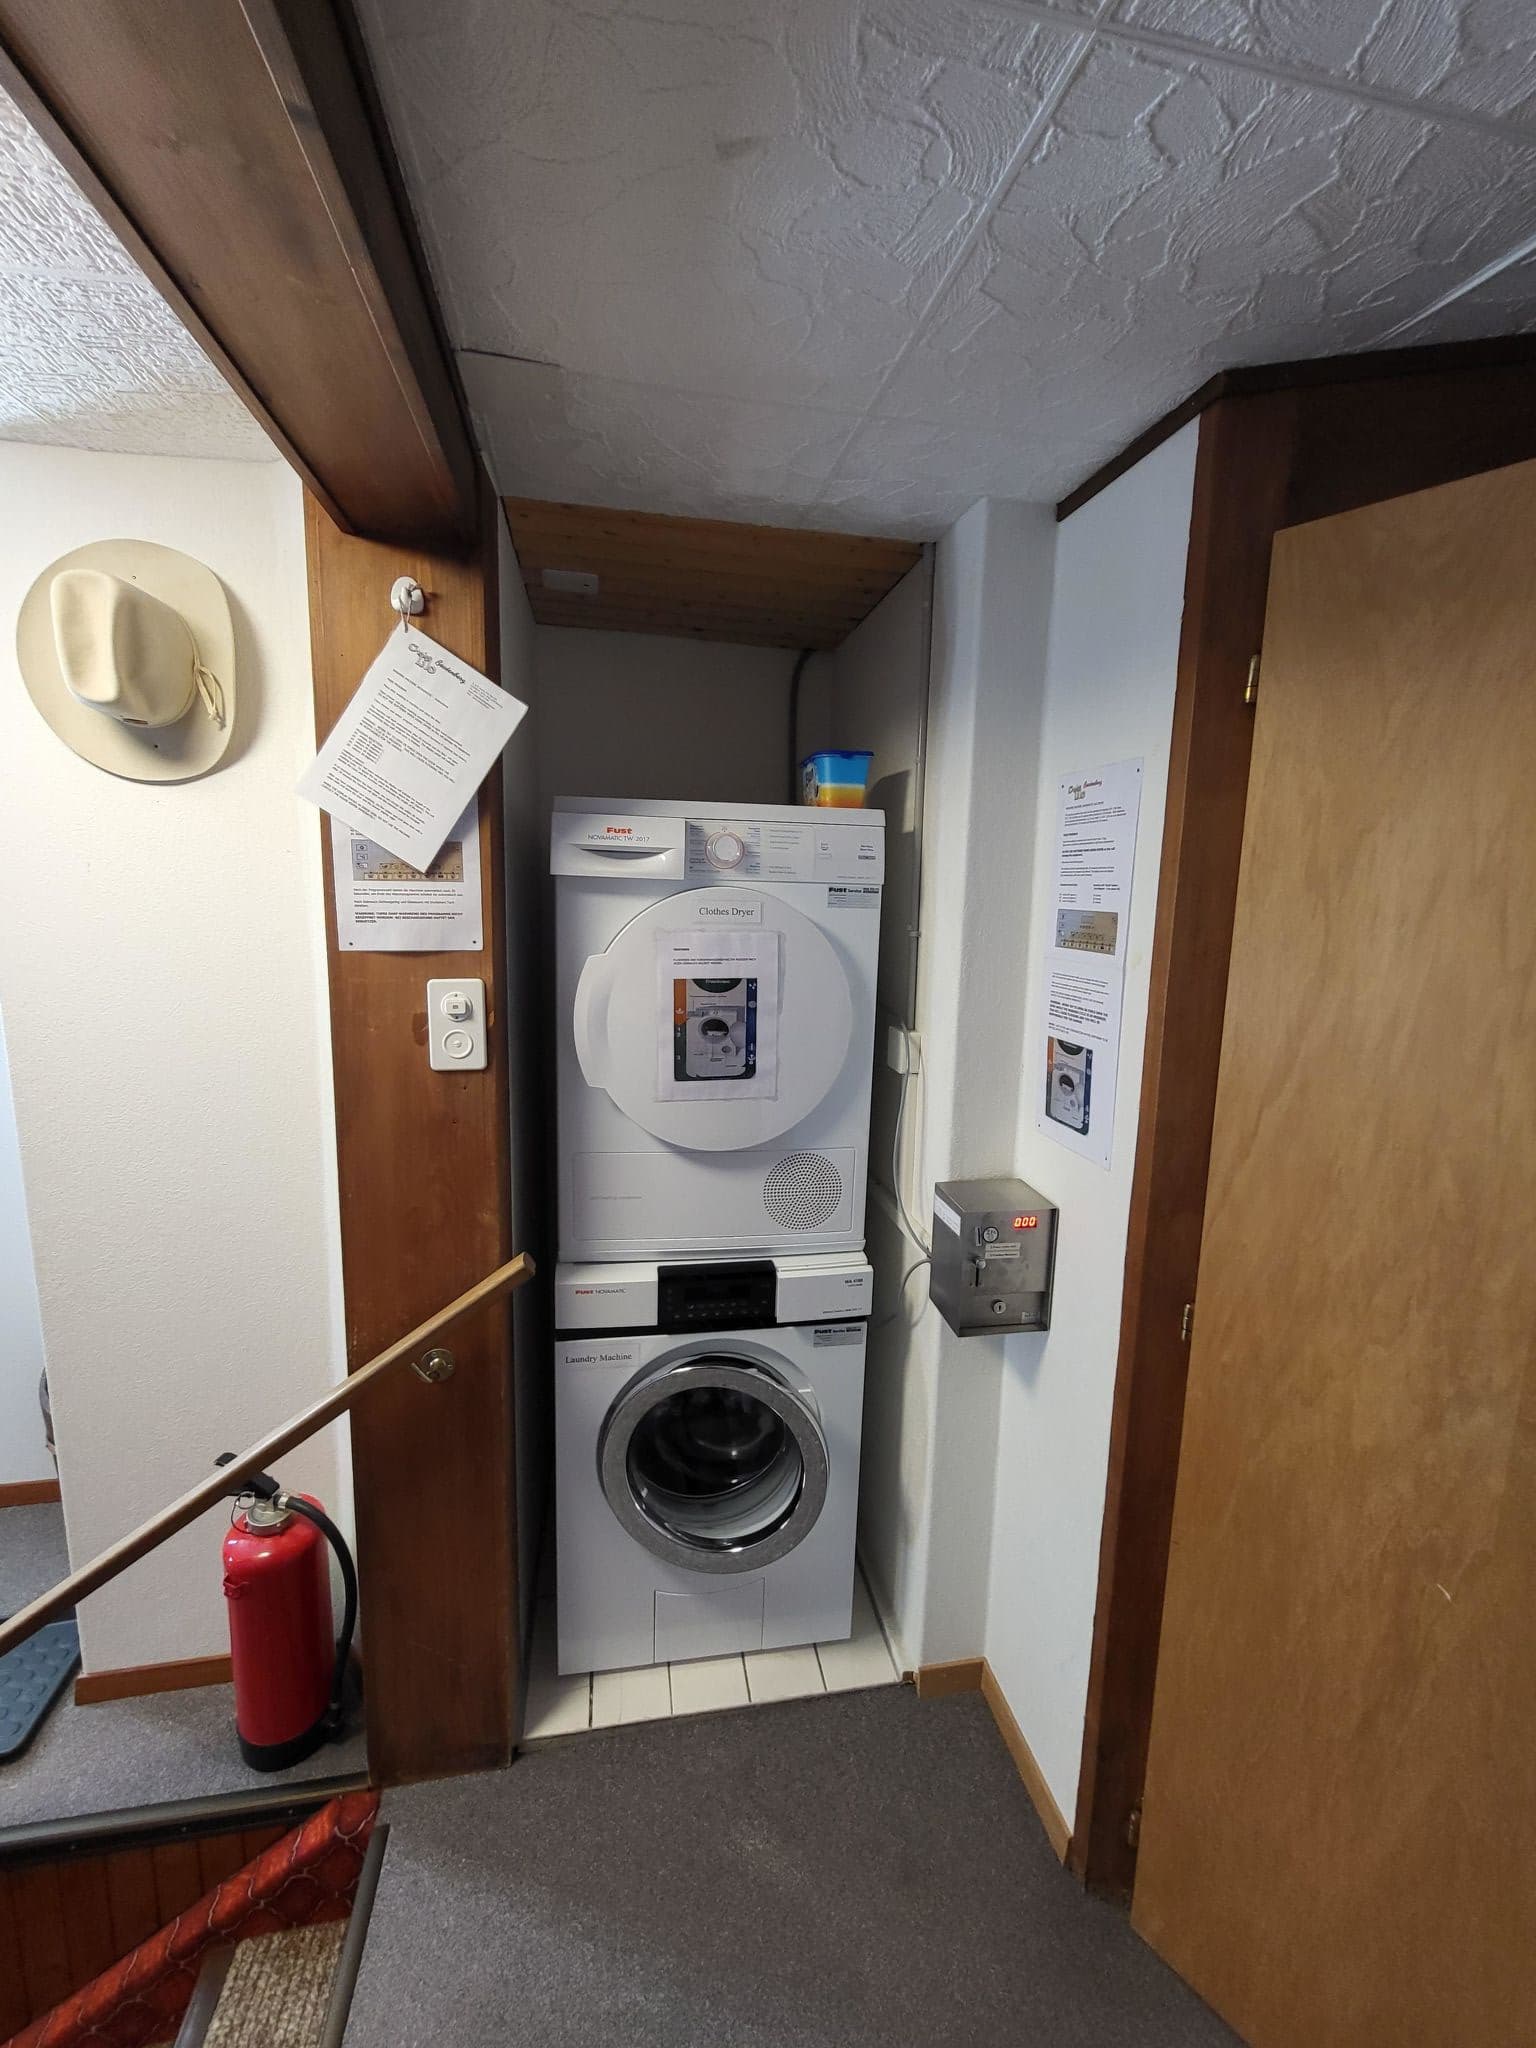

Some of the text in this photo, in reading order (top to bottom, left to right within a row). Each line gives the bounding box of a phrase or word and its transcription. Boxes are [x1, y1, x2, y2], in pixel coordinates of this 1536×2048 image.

[698, 907, 754, 917] Clothes Dryer
[565, 1352, 633, 1364] Laundry Machine
